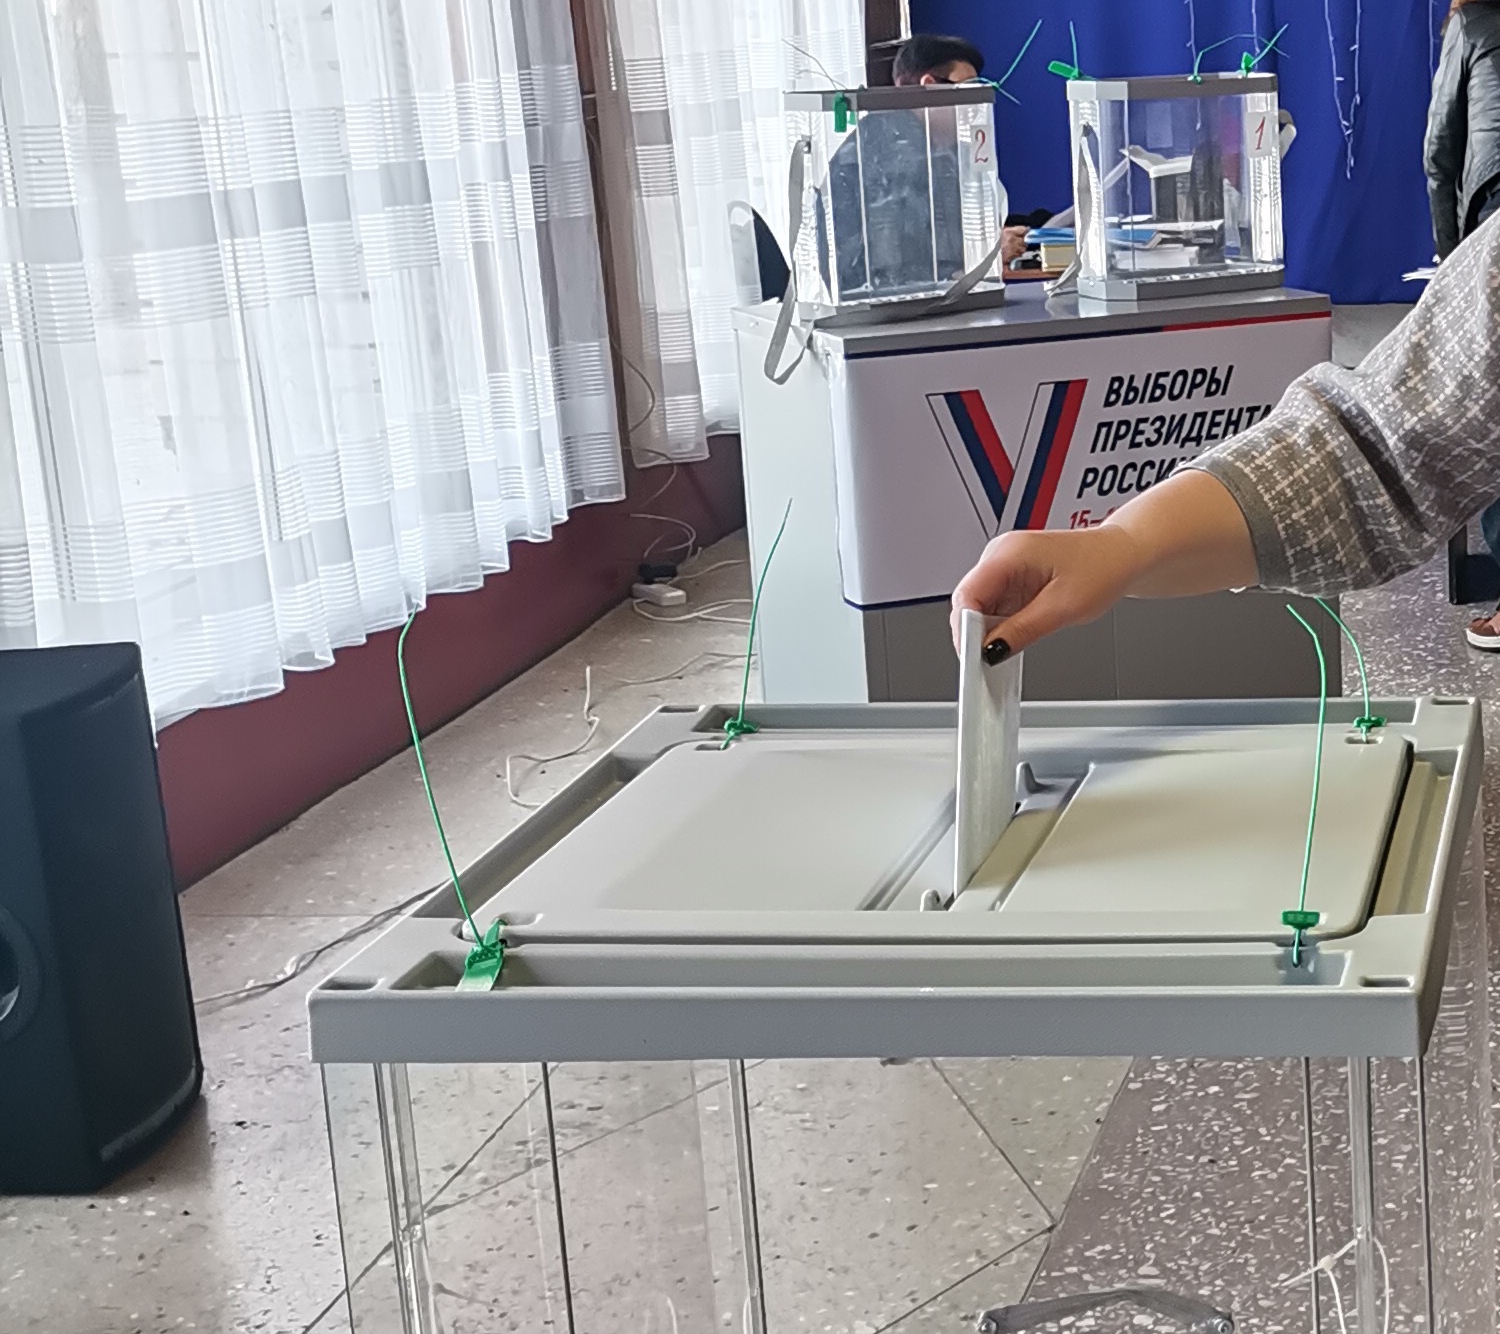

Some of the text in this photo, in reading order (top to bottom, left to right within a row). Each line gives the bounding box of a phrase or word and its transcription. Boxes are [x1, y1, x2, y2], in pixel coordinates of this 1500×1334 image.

[974, 128, 989, 164] 2
[1254, 115, 1266, 151] 1
[1102, 364, 1235, 409] ВЫБОРЫ
[1075, 454, 1198, 499] РОССИ
